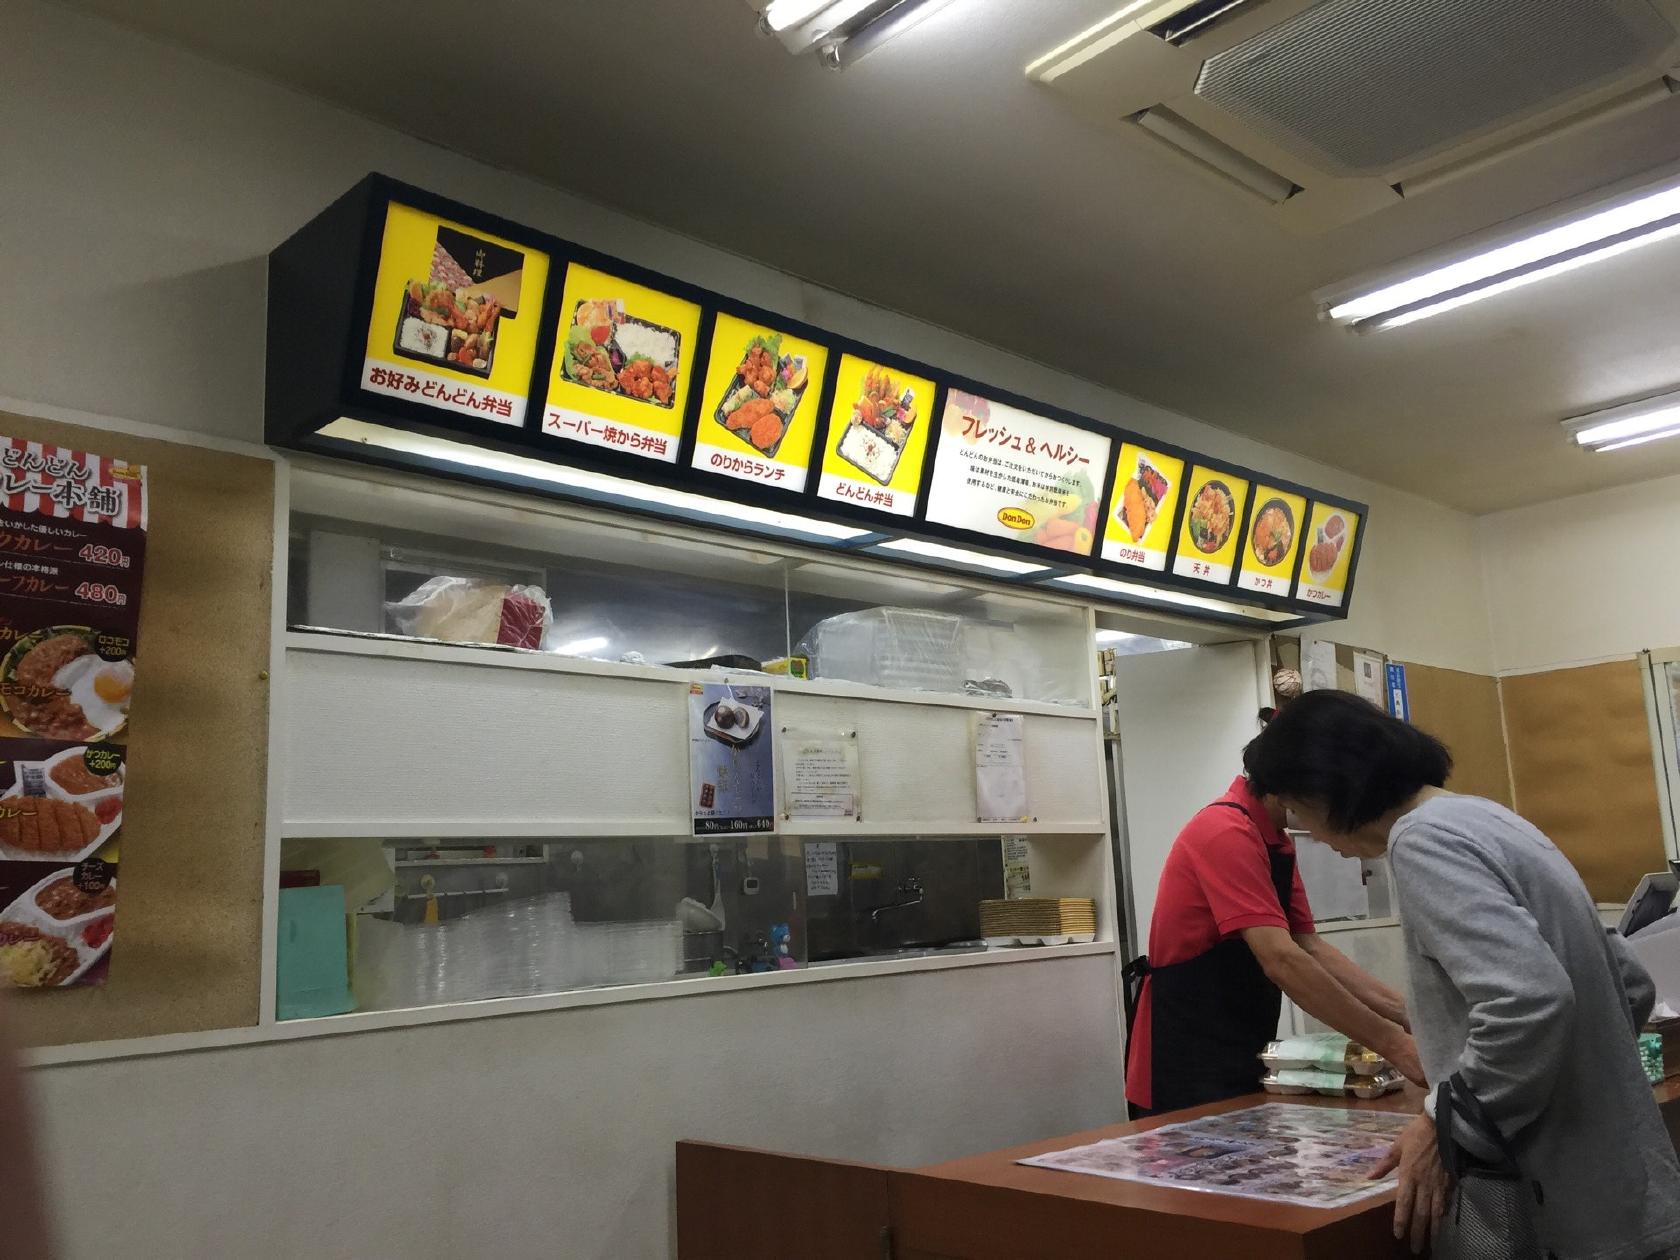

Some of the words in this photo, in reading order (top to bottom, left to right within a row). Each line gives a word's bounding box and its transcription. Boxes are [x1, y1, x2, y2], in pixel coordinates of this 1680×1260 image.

[370, 367, 513, 417] お好みどんどん弁当
[547, 412, 667, 455] スーパー焼から弁当
[2, 448, 91, 480] どんどん
[710, 453, 785, 481] のりからランチ
[0, 474, 121, 515] レー本舗
[836, 482, 894, 507] どんどん弁当
[79, 544, 131, 568] 420円
[1119, 548, 1145, 564] のり弁当
[74, 581, 127, 606] 480円
[1254, 577, 1272, 589] かつ丼
[1306, 588, 1331, 600] かつカレー
[86, 749, 121, 760] かつカレー
